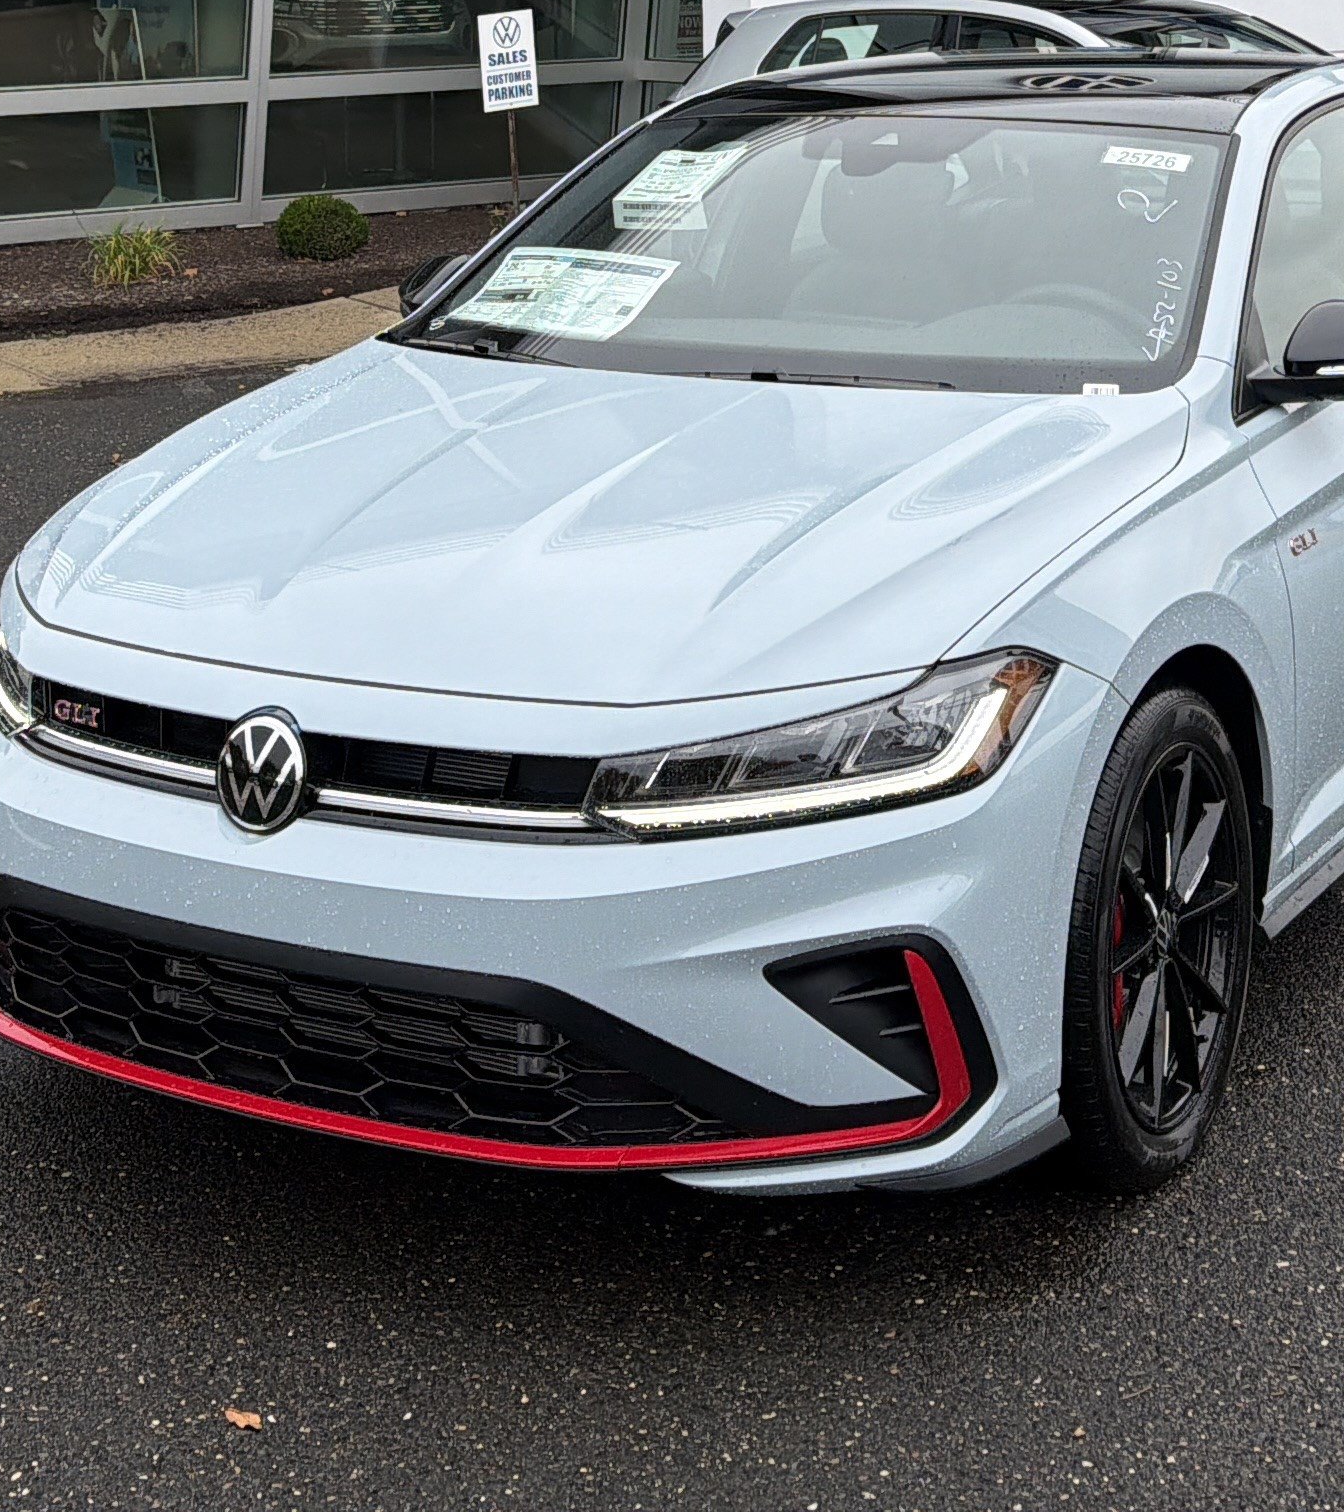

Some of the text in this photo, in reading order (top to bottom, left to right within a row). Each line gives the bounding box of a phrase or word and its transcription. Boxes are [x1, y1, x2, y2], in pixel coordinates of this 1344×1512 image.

[488, 50, 528, 67] SALES
[487, 70, 532, 86] CUSTOMER
[488, 83, 533, 102] PARKING
[1117, 151, 1177, 168] 25726
[54, 699, 101, 729] GLI
